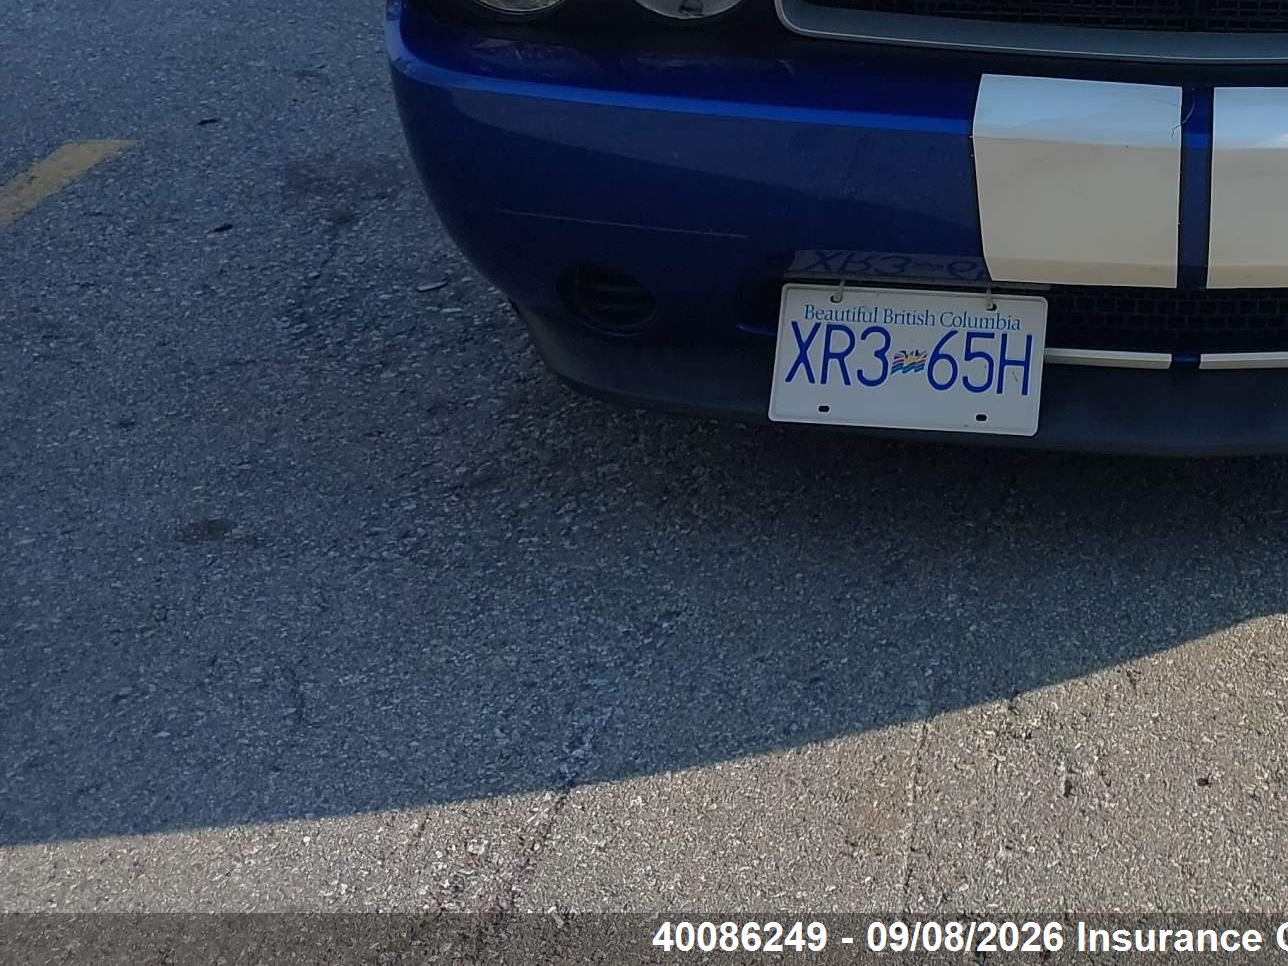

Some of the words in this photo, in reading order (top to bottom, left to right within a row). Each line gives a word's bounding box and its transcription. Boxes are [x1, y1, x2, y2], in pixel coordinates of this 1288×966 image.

[804, 304, 878, 325] Beautiful
[882, 309, 936, 327] British
[939, 311, 1021, 331] Columbia
[785, 320, 892, 387] XR3
[926, 330, 1033, 396] 65H
